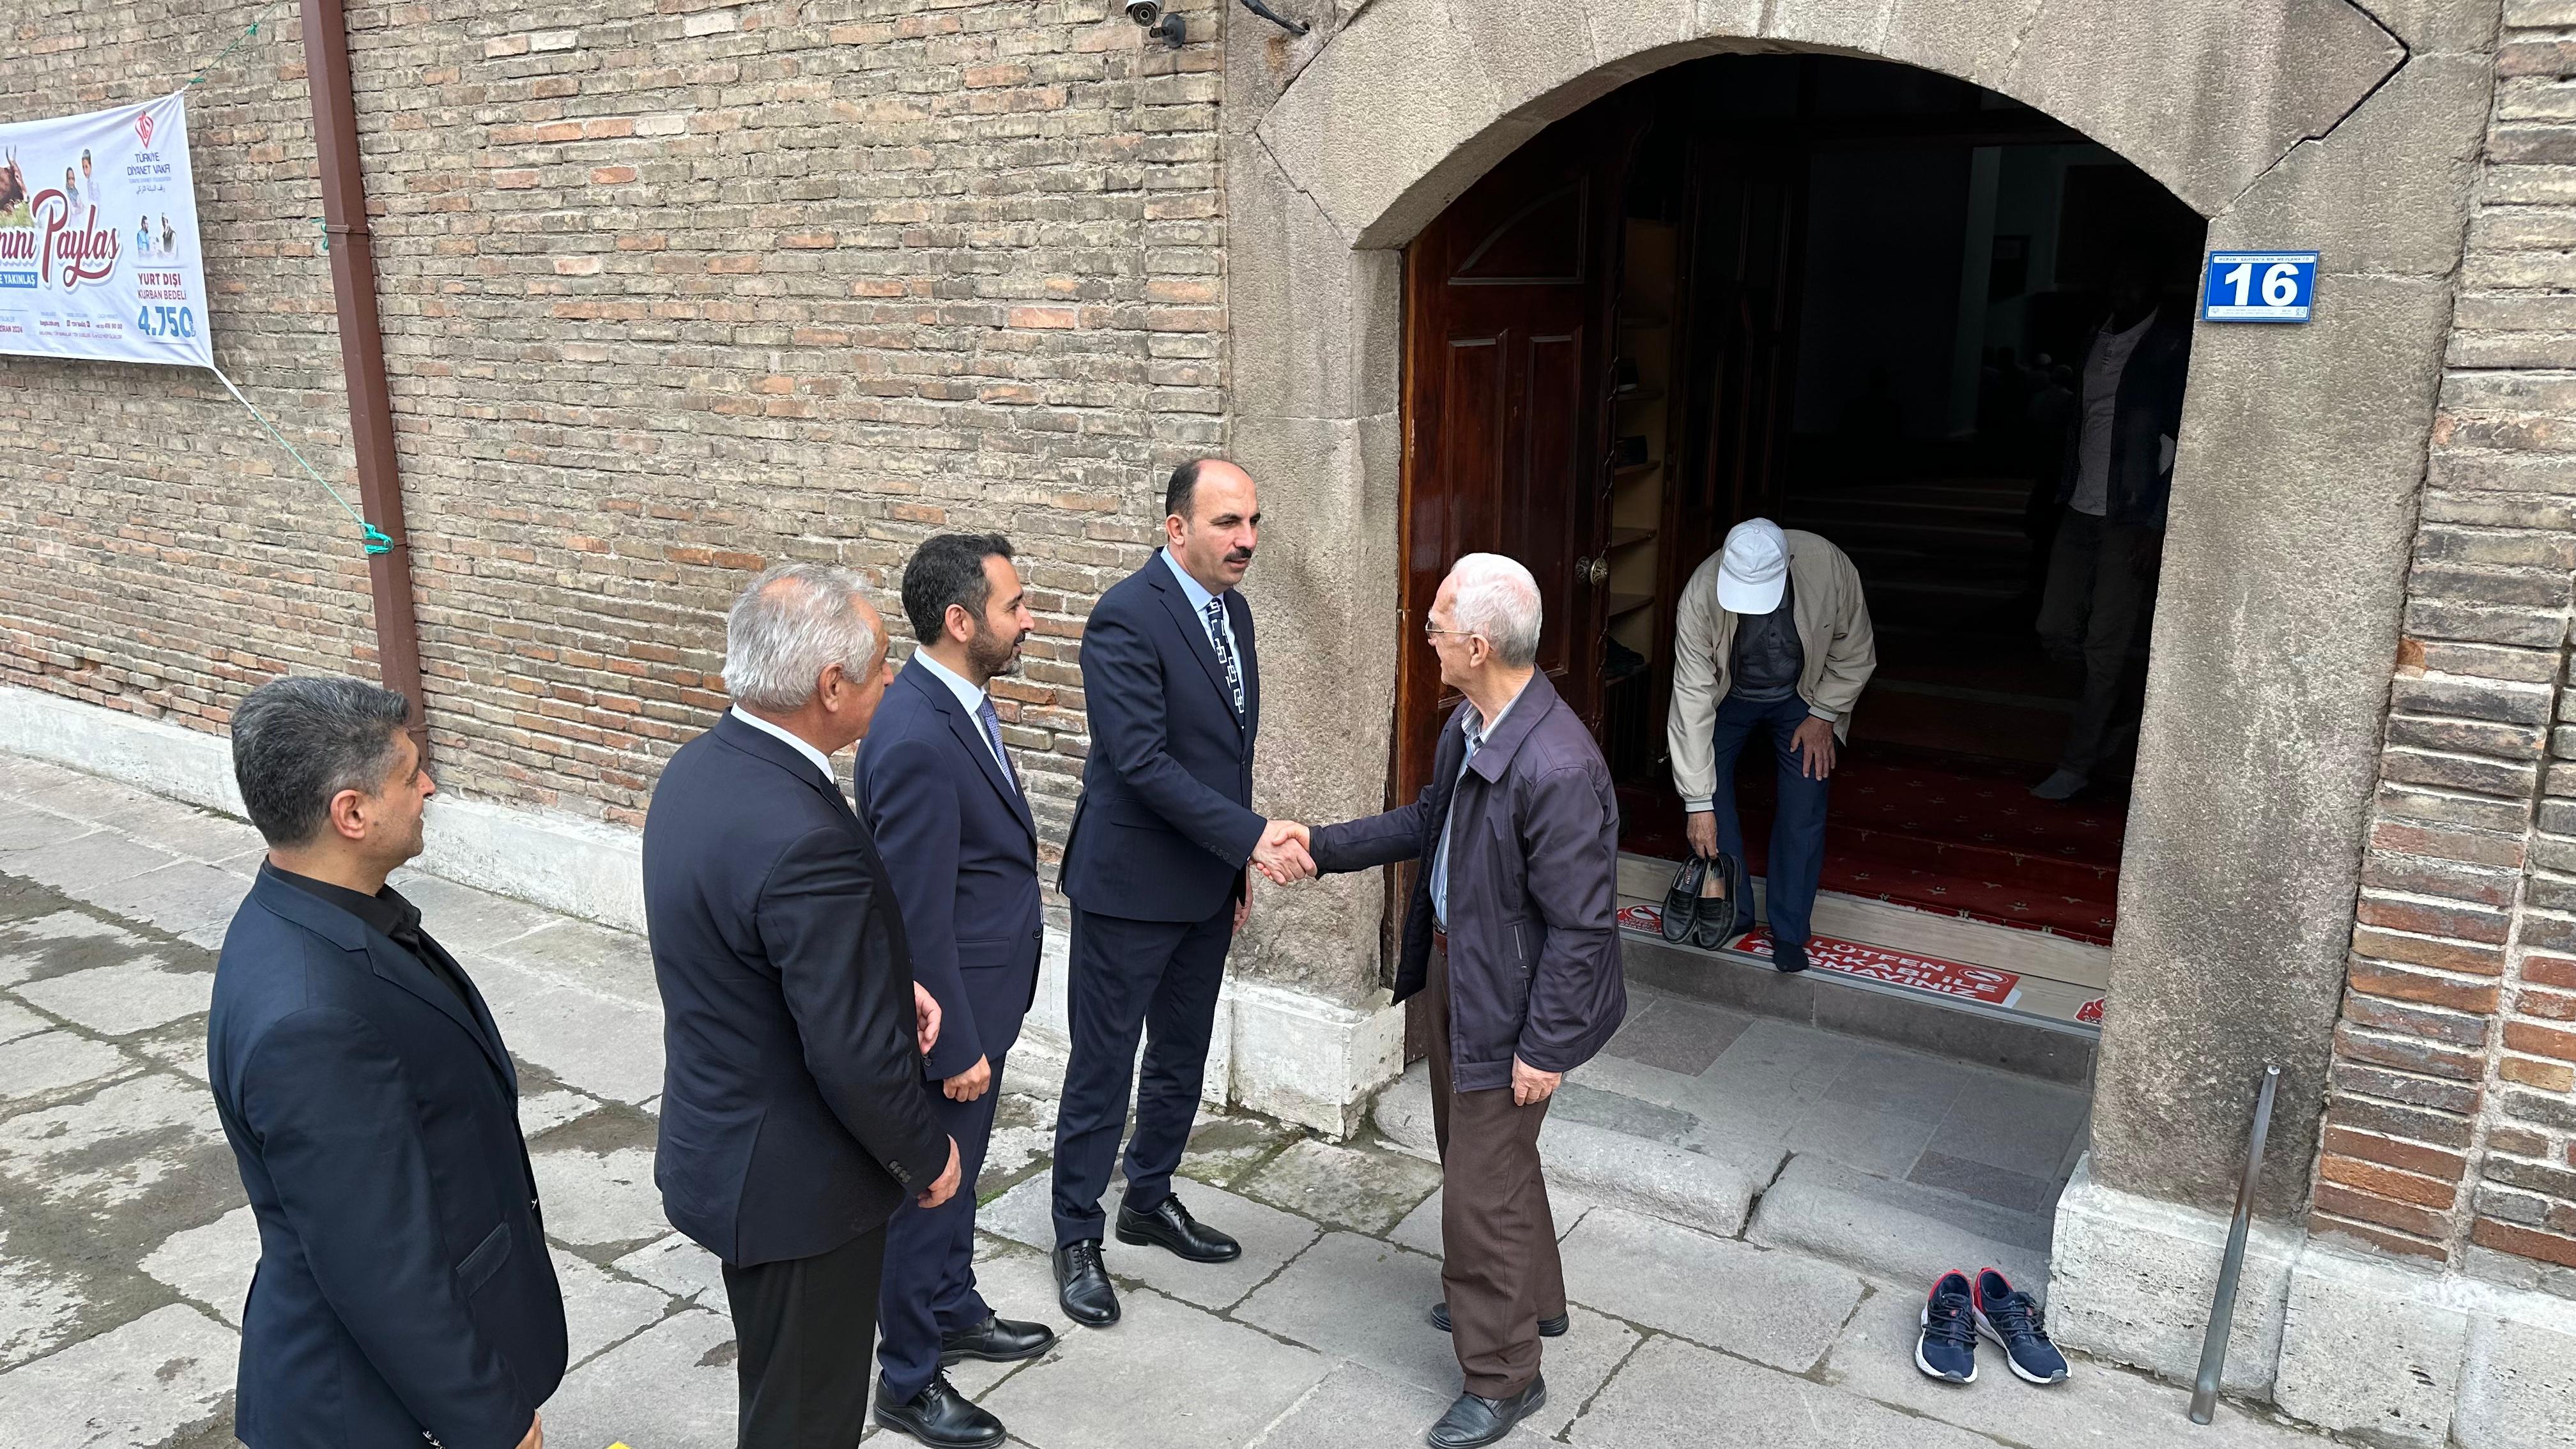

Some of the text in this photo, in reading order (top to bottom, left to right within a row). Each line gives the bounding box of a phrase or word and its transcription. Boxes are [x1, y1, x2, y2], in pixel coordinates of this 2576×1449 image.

[127, 165, 151, 175] DİYANET
[3, 274, 35, 287] YAKINLAŞ
[138, 273, 181, 288] YURT DIŞI
[2225, 263, 2299, 307] 16
[137, 289, 163, 300] KURBAN
[1749, 939, 1932, 979] AAKKABI
[1813, 940, 1946, 972] LÜTFEN
[1752, 946, 1979, 998] BSMAYINIZ
